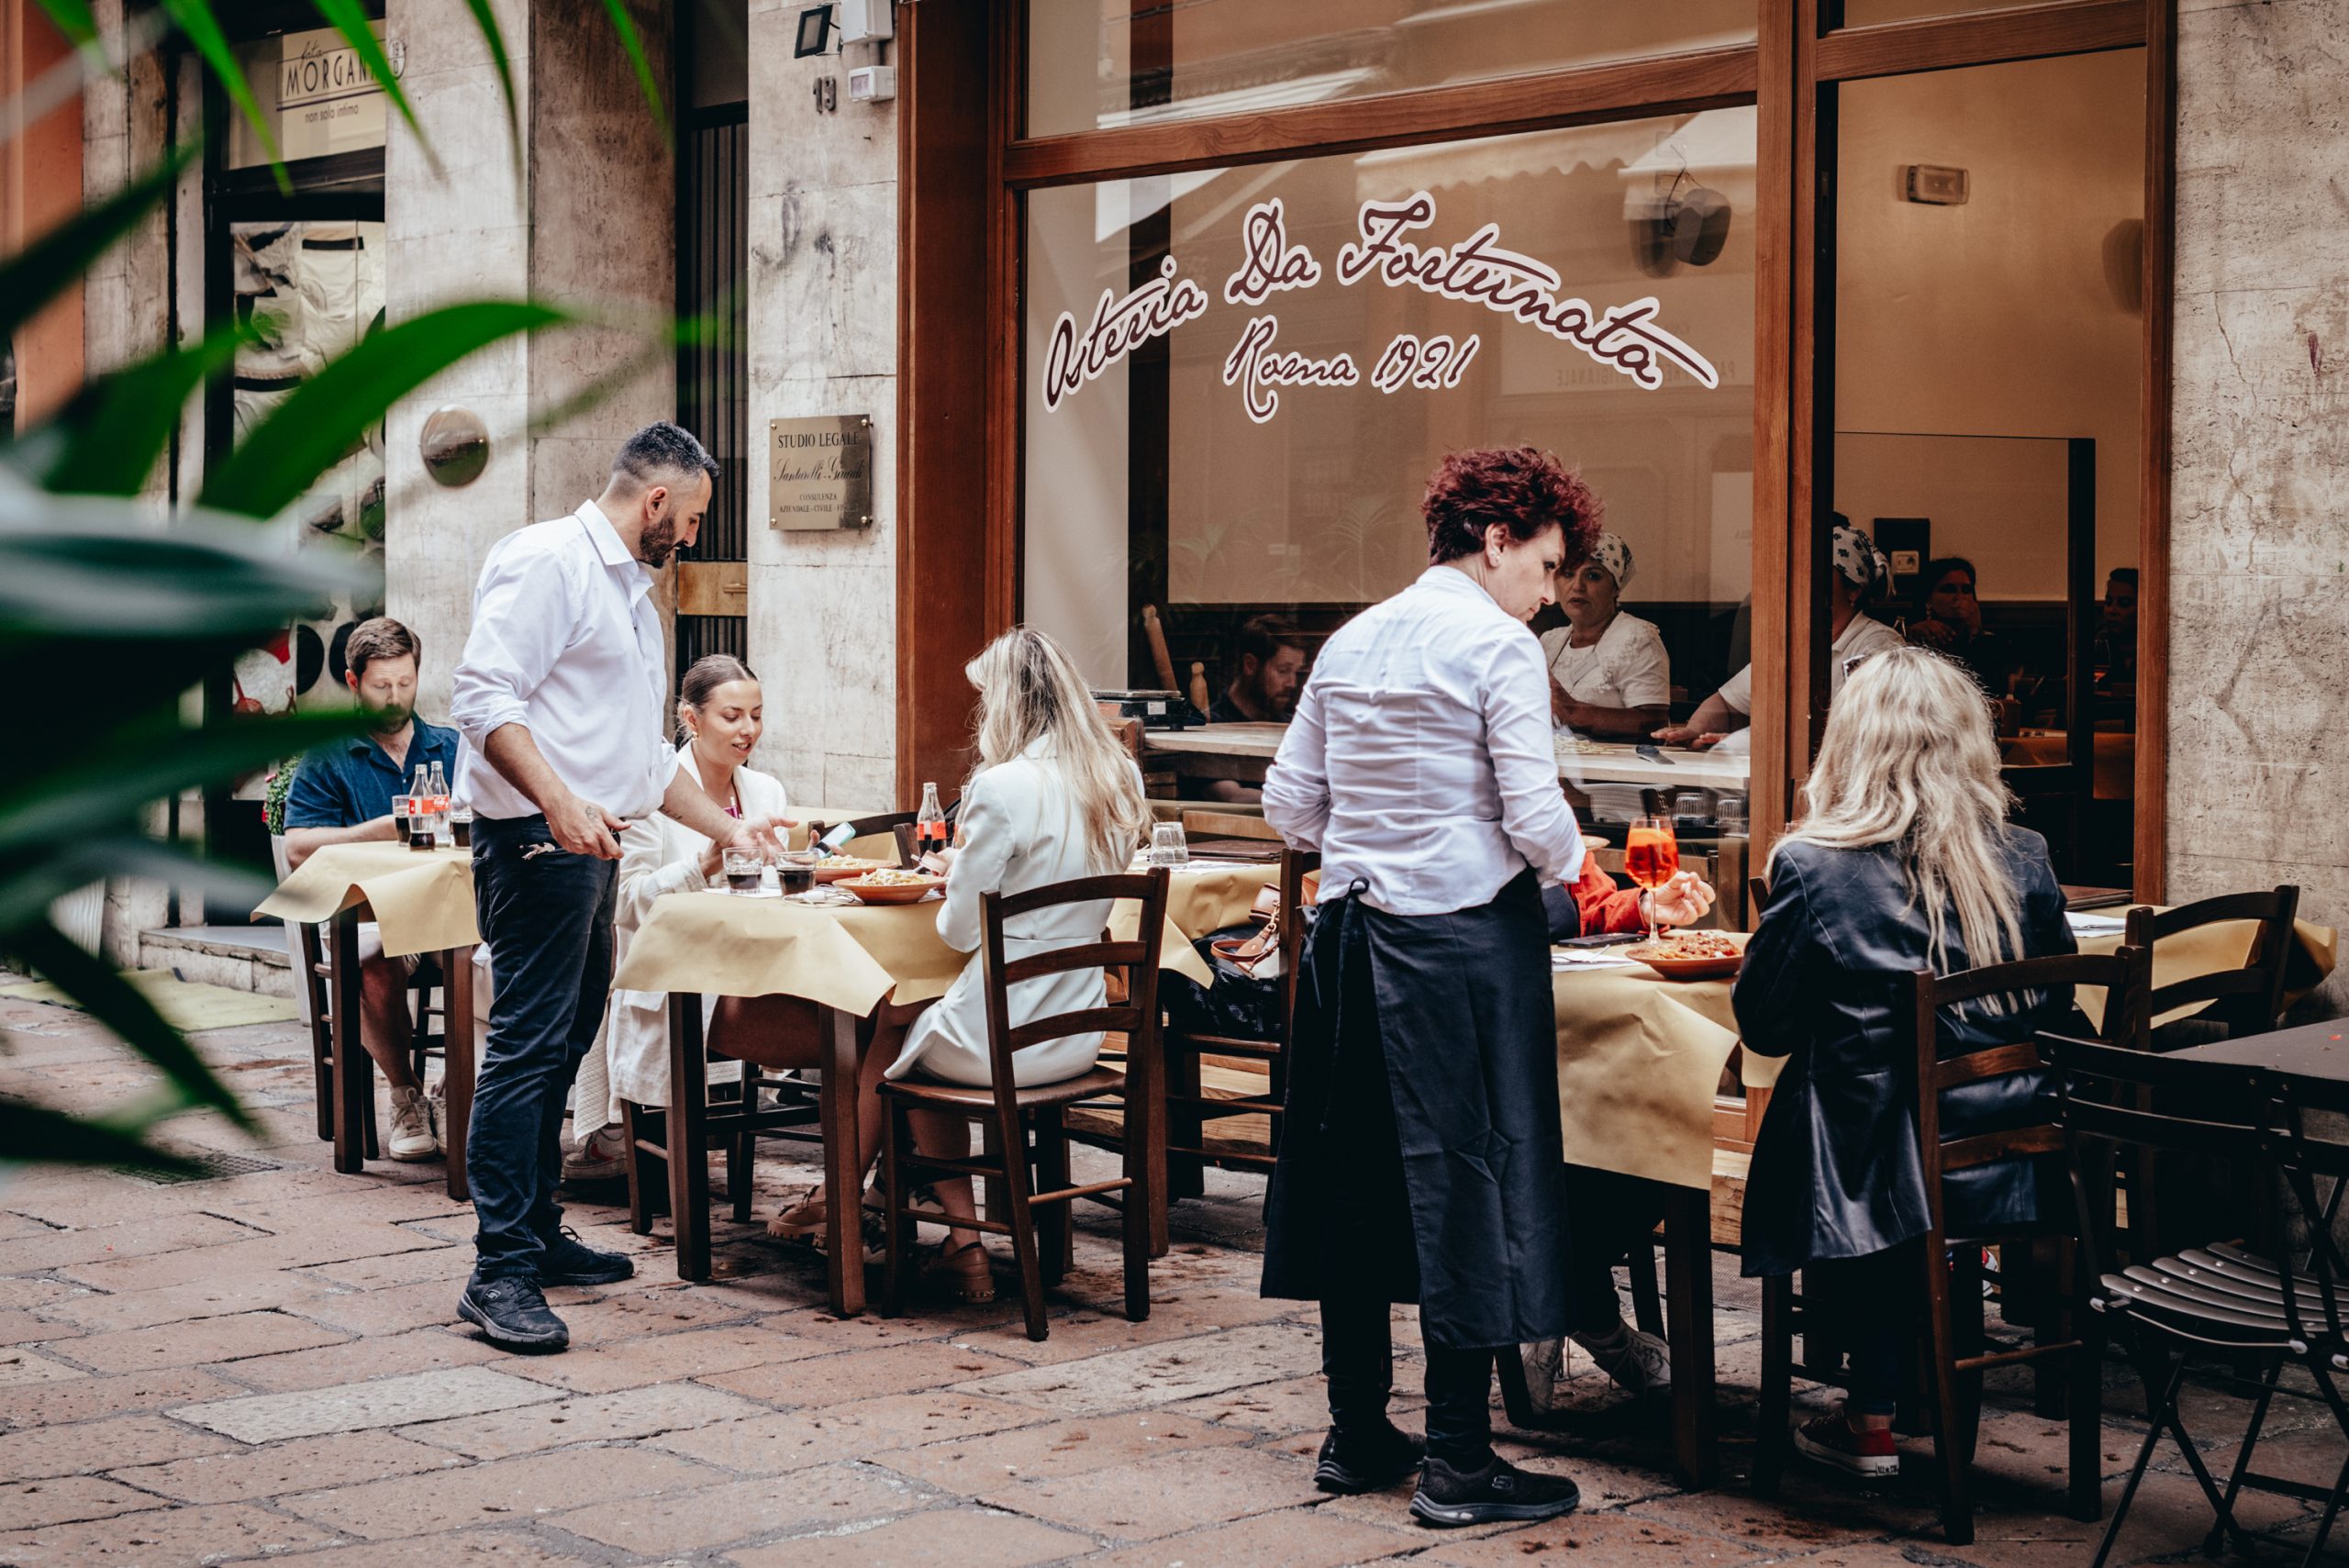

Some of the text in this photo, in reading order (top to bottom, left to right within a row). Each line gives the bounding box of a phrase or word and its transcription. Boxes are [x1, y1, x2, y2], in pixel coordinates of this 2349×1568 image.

[305, 112, 318, 124] non
[337, 102, 359, 117] intimo
[1043, 191, 1718, 412] Osteria Da Fortunata
[1223, 317, 1479, 422] Roma 1921
[778, 431, 860, 449] STUDIO LEGALE
